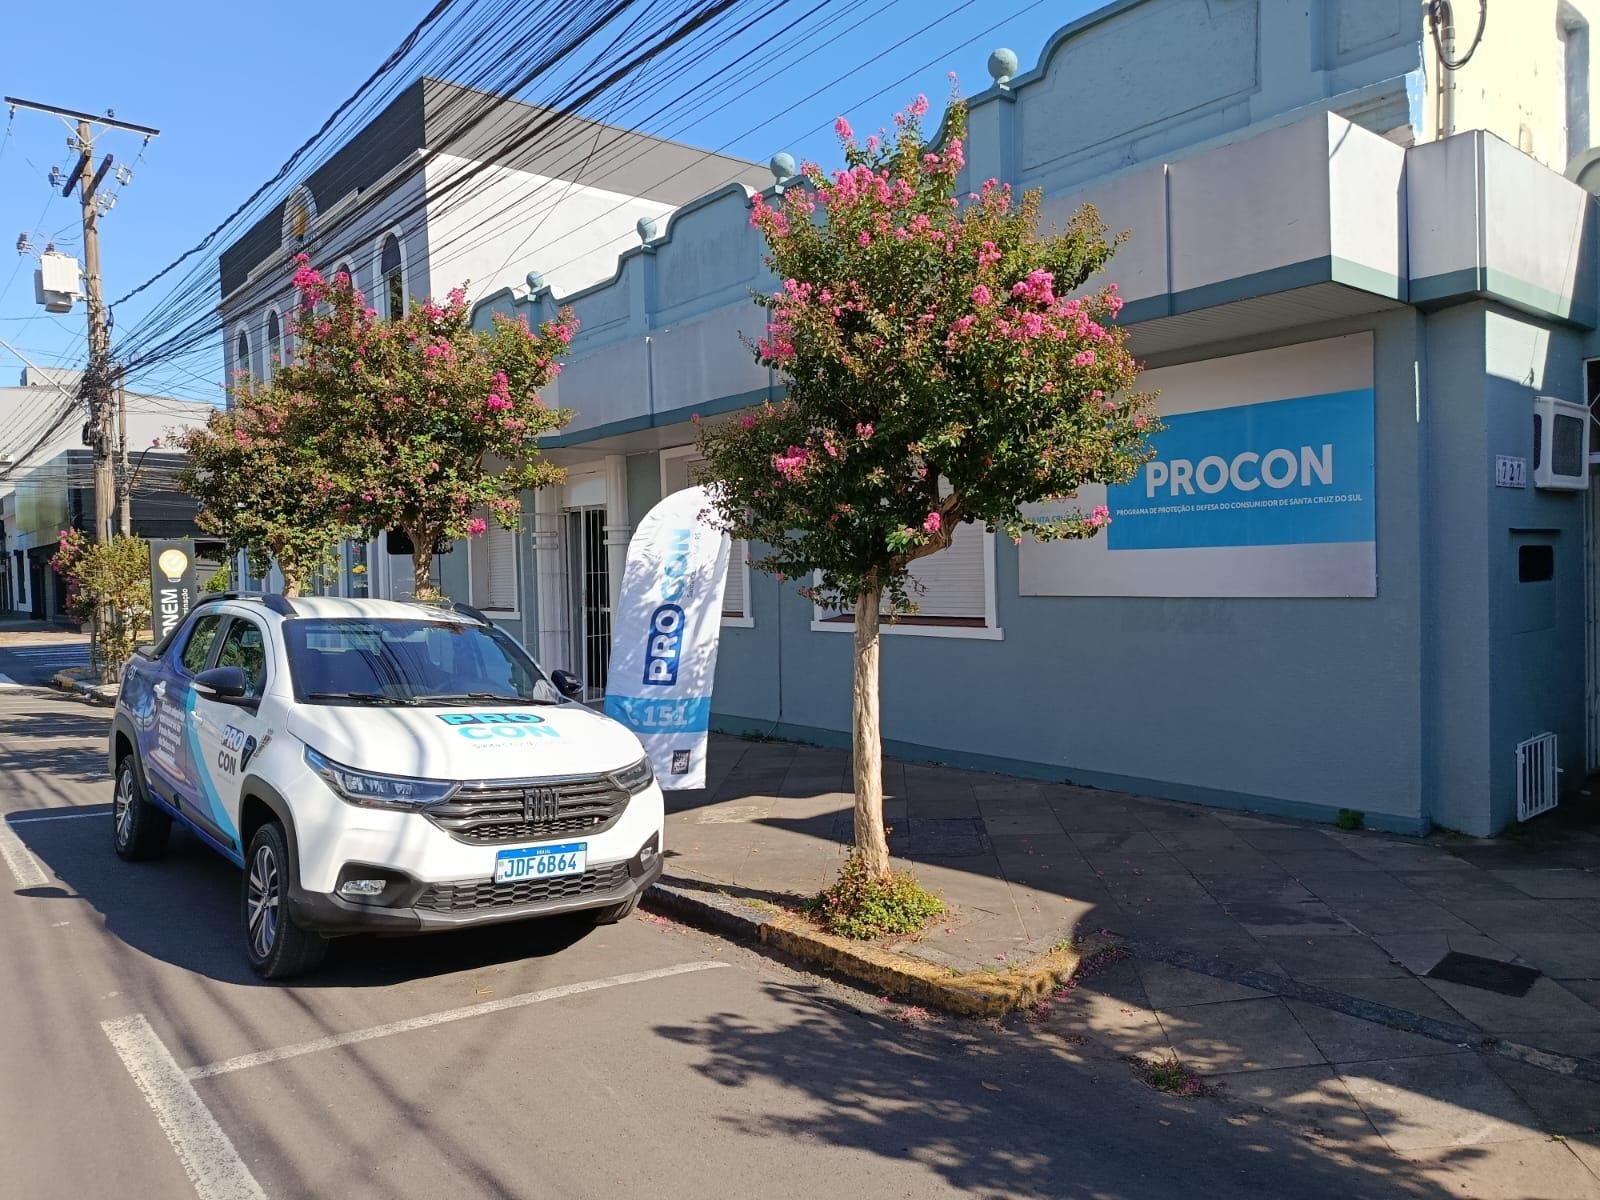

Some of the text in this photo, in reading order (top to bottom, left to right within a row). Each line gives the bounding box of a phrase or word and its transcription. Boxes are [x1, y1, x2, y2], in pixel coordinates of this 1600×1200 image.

[1146, 444, 1333, 498] PROCON
[1502, 461, 1522, 481] 727
[1116, 508, 1149, 516] PROGRAMA
[1158, 504, 1190, 514] PROTEÇÃO
[1196, 503, 1219, 511] DEFESA
[1231, 499, 1278, 509] CONSUMIDOR
[1279, 498, 1289, 506] DE
[1289, 497, 1313, 505] SANTA
[1313, 496, 1334, 504] CRUZ
[1335, 494, 1347, 502] DO
[1347, 493, 1362, 502] SUL
[440, 713, 542, 725] PRO
[643, 706, 688, 727] 151
[222, 727, 244, 752] PRO
[457, 725, 561, 740] CON
[218, 750, 237, 776] CON
[504, 853, 577, 878] JDF6B64
